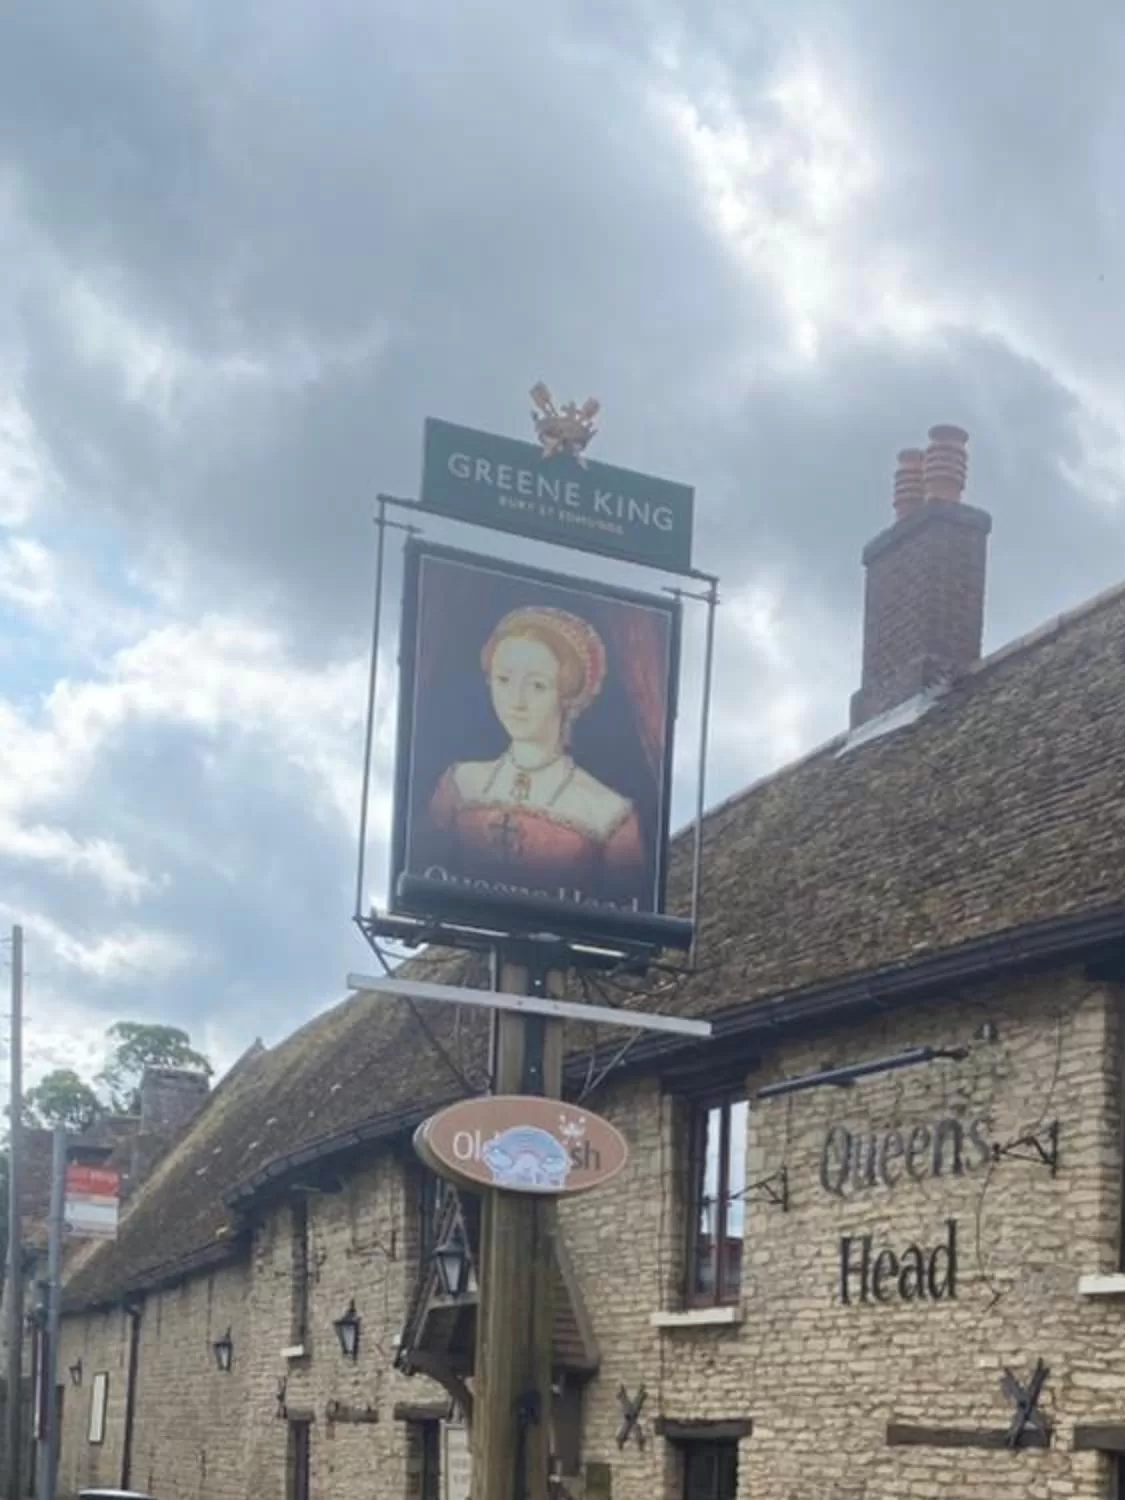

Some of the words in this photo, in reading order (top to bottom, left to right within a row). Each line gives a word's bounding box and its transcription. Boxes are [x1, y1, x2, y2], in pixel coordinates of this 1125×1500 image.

[447, 452, 581, 506] GREENE
[593, 489, 673, 531] KING
[820, 1118, 993, 1199] Queens
[840, 1219, 958, 1307] Head
